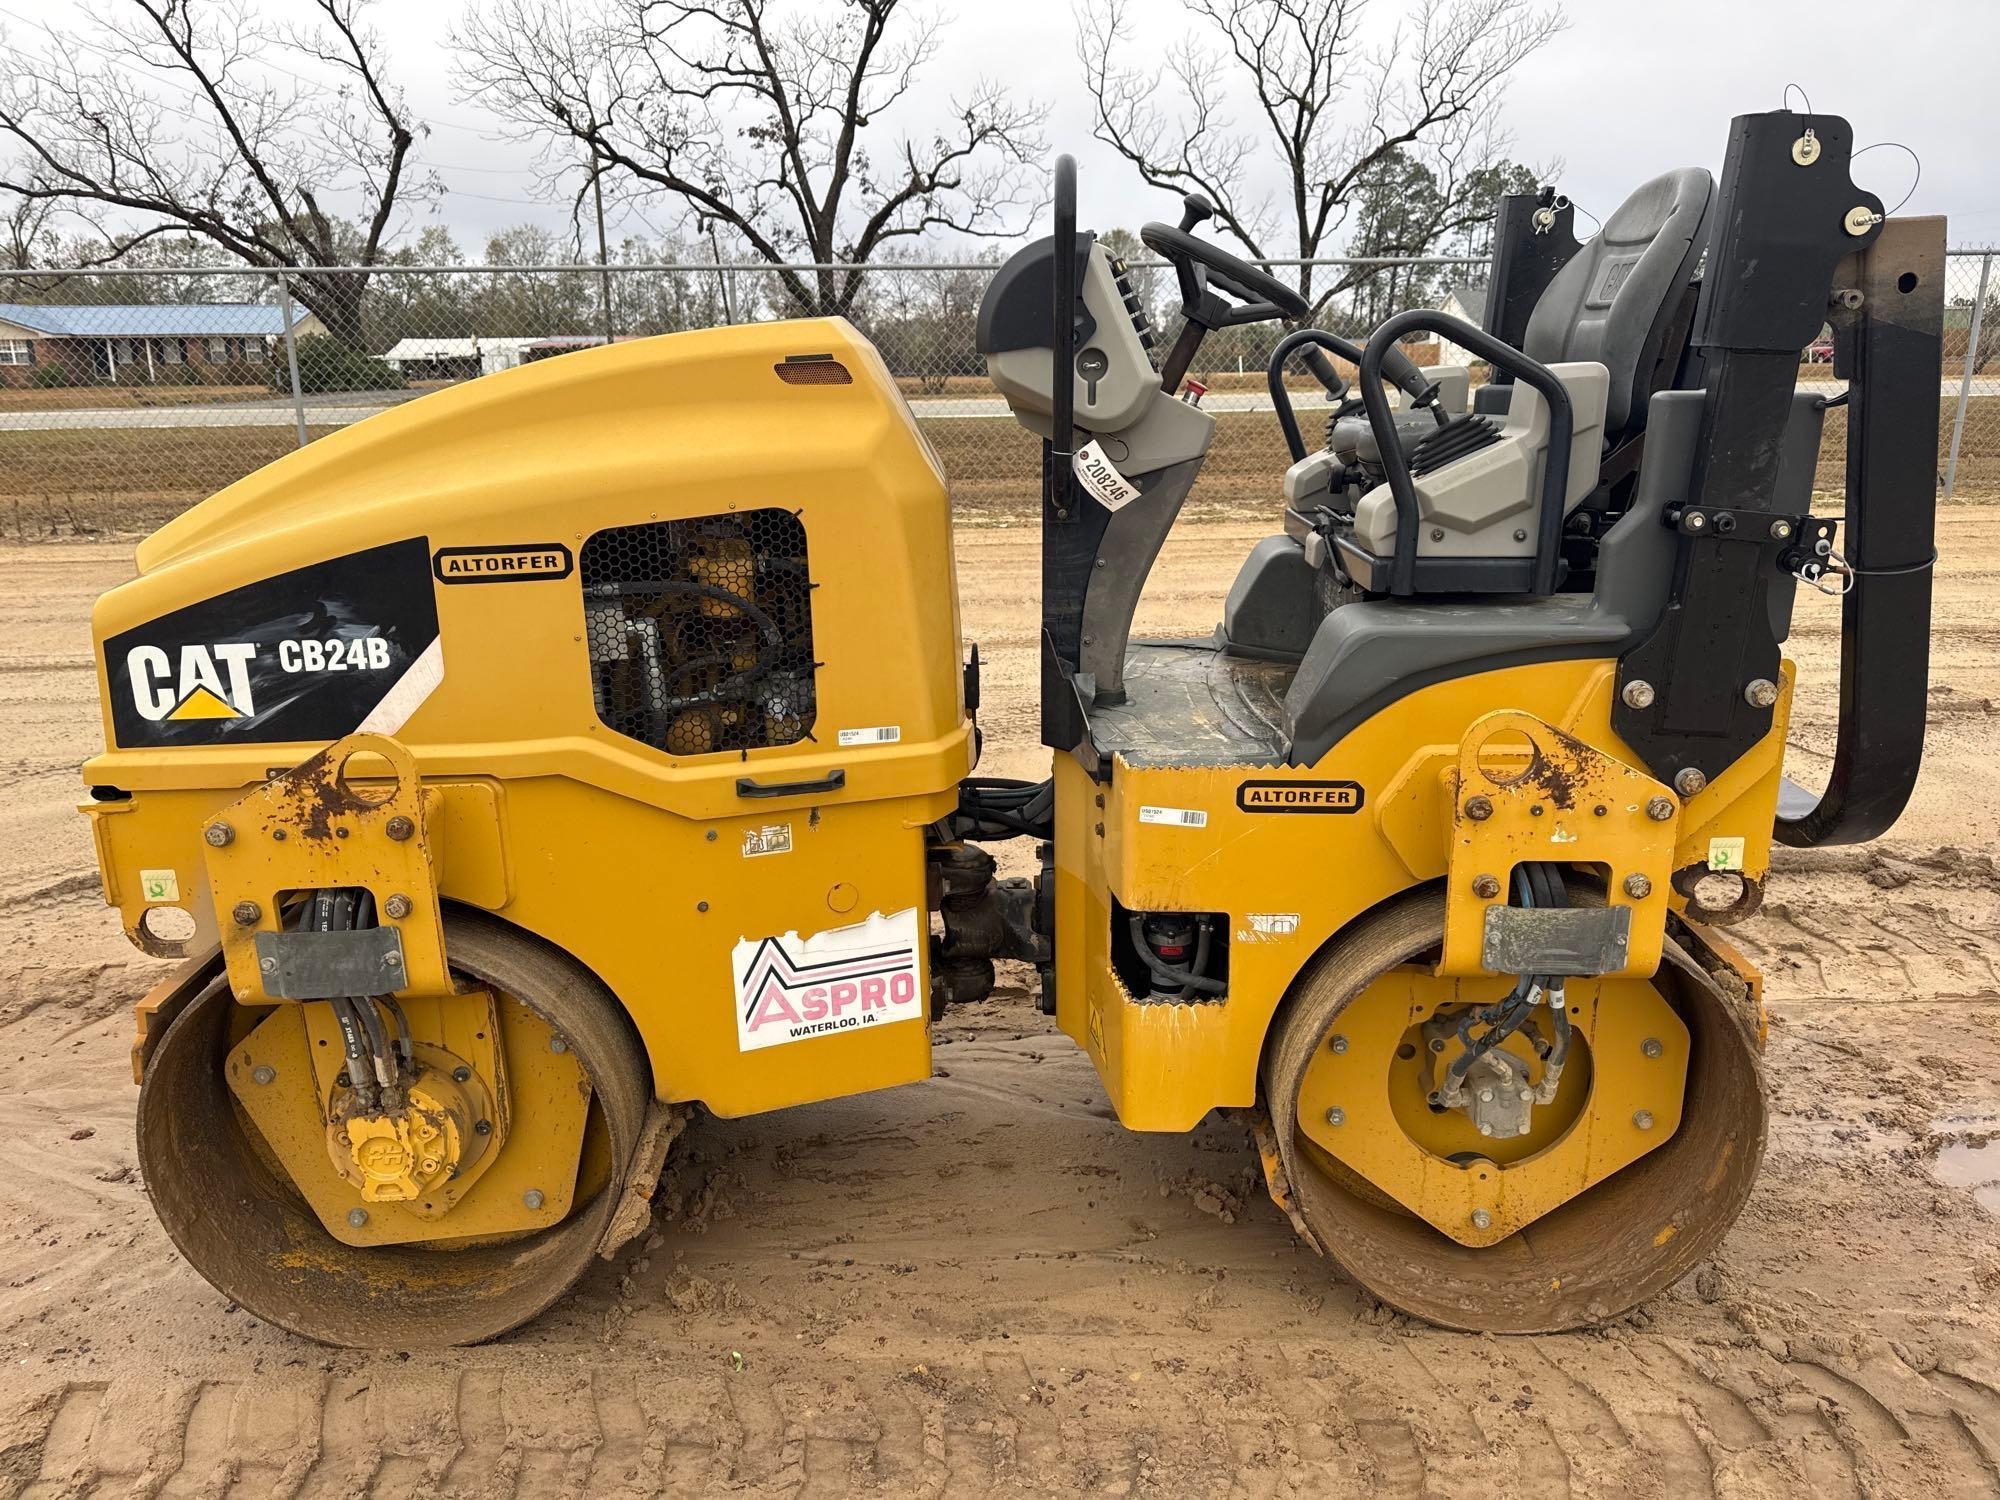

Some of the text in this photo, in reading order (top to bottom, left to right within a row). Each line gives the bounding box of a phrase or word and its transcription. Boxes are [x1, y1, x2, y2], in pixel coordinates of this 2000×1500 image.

[1086, 459, 1128, 500] 208246
[449, 555, 558, 573] ALTORFER
[278, 637, 391, 673] CB24B
[127, 642, 256, 721] CAT
[1250, 790, 1350, 804] ALTORFER
[747, 972, 915, 1033] ASPRO
[789, 1013, 879, 1038] WATERLOO, IA.
